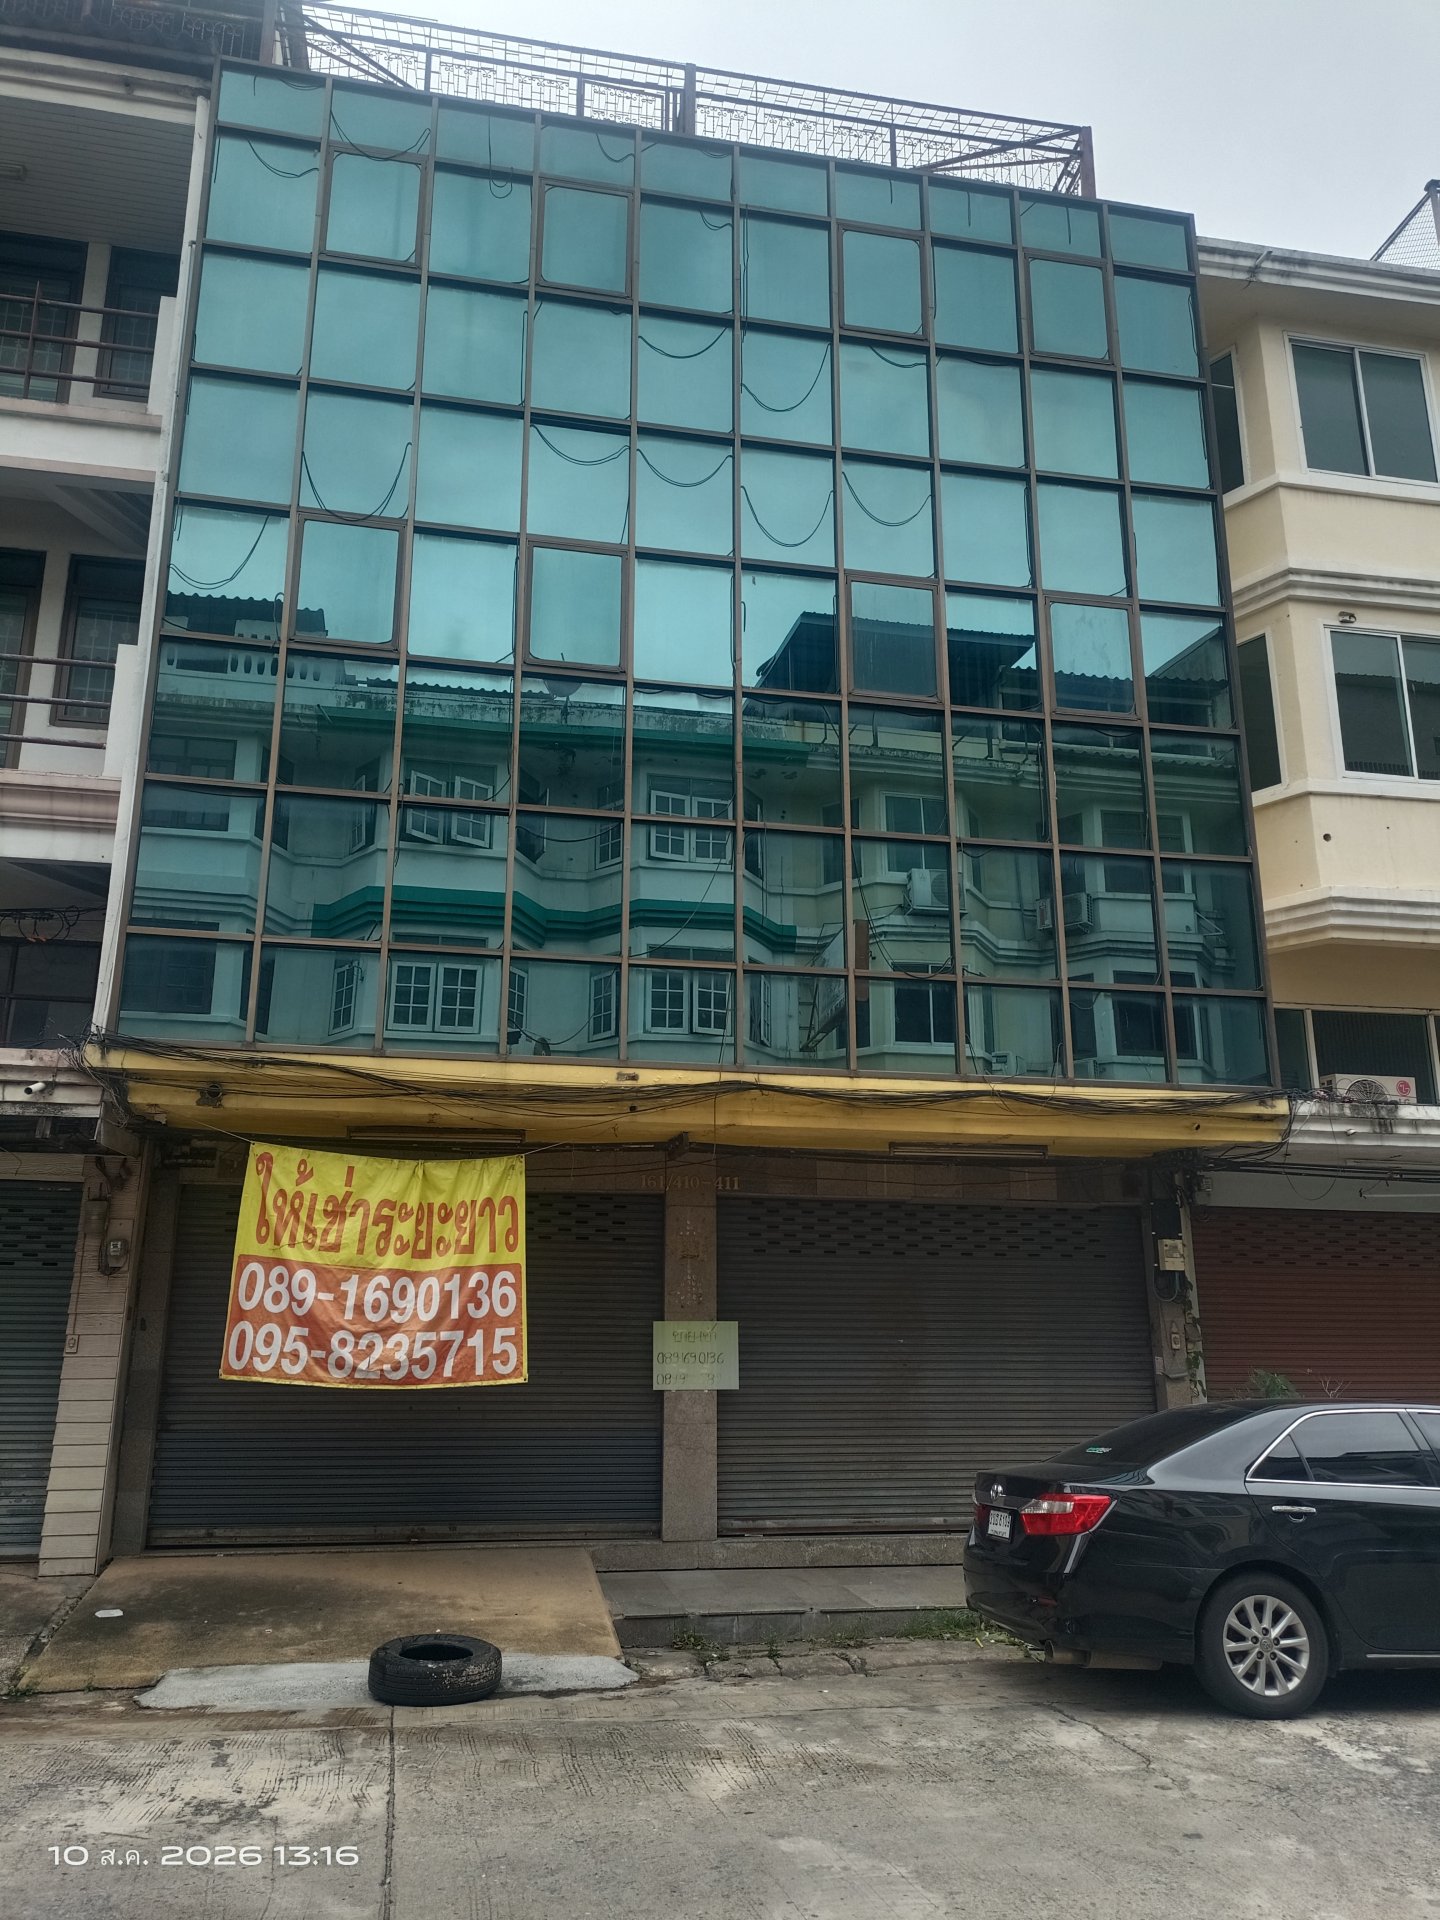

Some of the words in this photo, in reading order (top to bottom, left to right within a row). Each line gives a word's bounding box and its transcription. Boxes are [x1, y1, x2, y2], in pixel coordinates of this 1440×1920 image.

[255, 1152, 519, 1259] ให้เช่าระยะยาว
[238, 1262, 517, 1324] 089-1690136
[228, 1320, 518, 1381] 095-8235715
